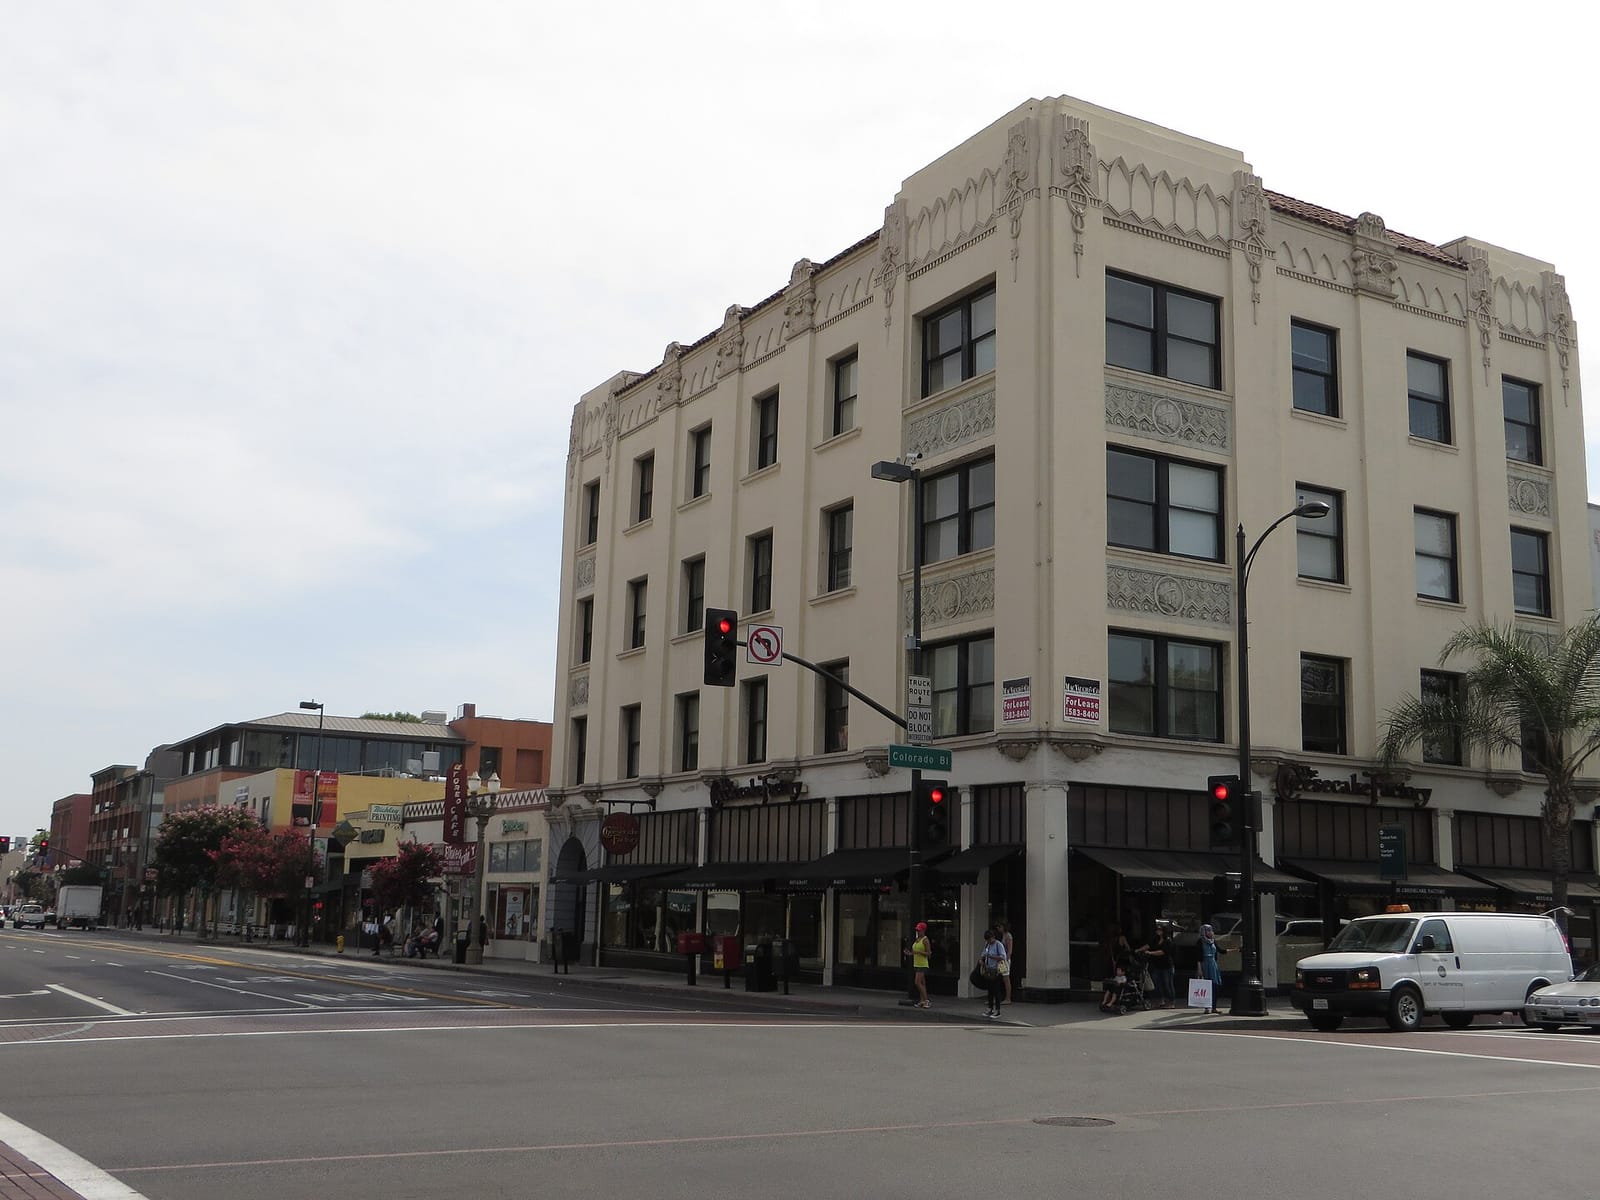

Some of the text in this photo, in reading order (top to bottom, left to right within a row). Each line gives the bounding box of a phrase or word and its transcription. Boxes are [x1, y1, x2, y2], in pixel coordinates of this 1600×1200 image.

[909, 679, 931, 687] TRUCK
[909, 688, 930, 696] ROUTE
[1065, 696, 1099, 709] For Lease
[908, 711, 931, 721] DO NOT
[1068, 708, 1099, 719] 583-8400
[908, 723, 931, 733] BLOCK
[893, 751, 934, 764] Colorado
[372, 813, 401, 821] PRINTING
